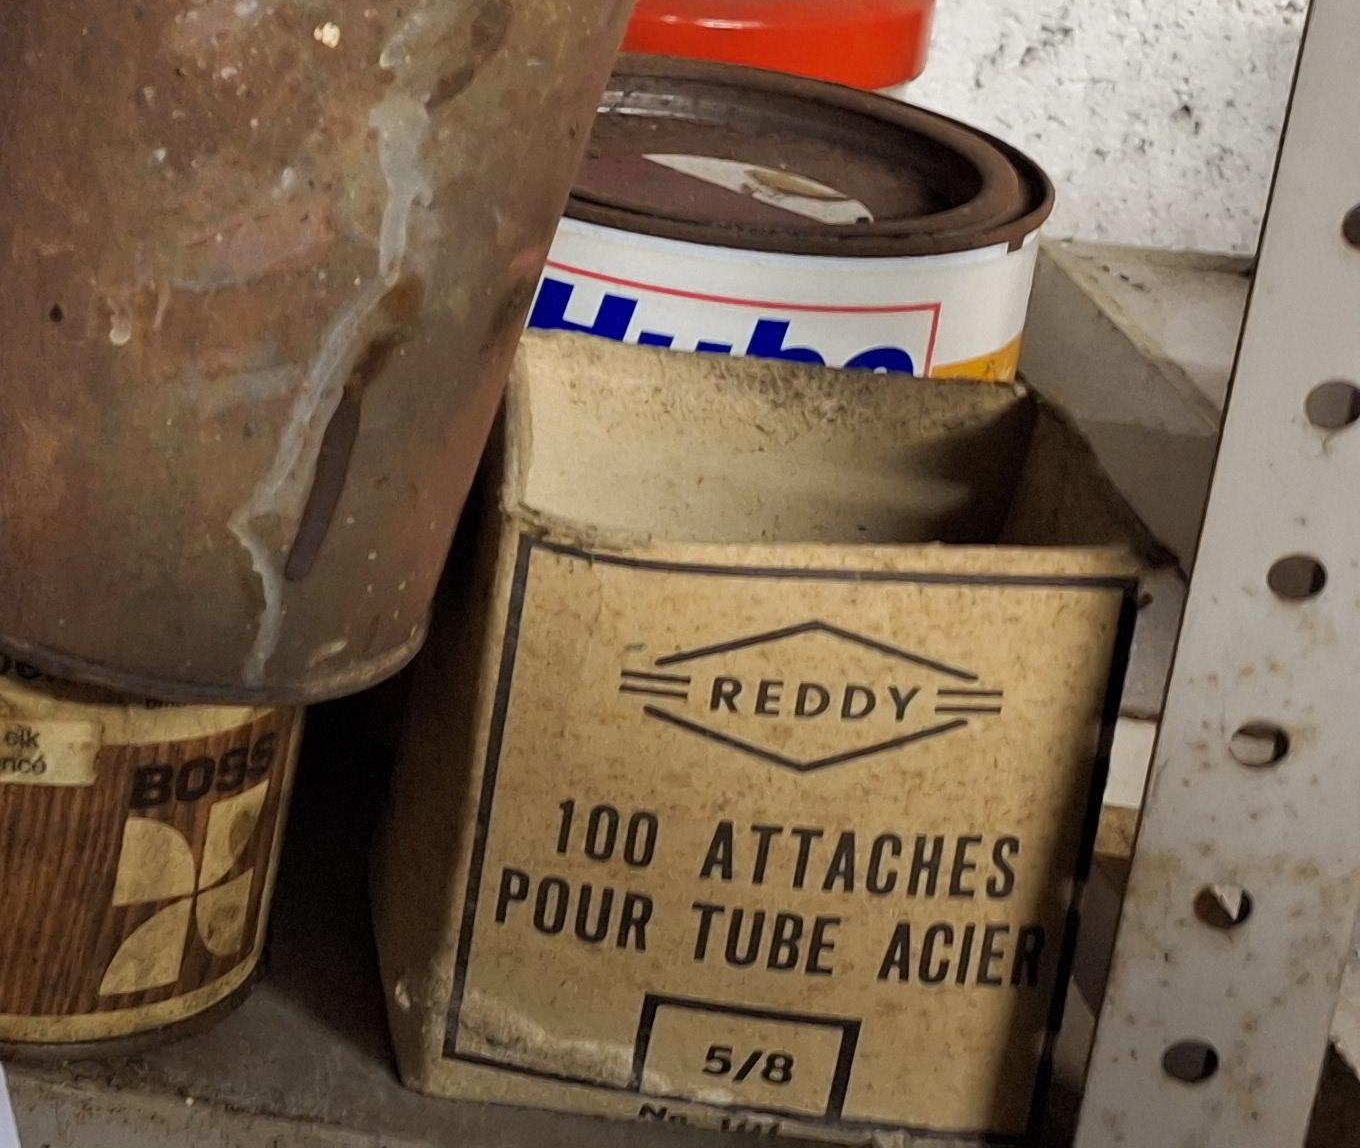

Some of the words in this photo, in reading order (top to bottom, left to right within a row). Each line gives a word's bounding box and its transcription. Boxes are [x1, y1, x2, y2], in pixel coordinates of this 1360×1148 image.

[708, 675, 922, 723] REDDY
[129, 731, 281, 810] BOSS
[555, 798, 660, 869] 100
[698, 819, 1021, 900] ATTACHES
[494, 867, 656, 952] POUR
[690, 901, 842, 976] TUBE
[877, 921, 1047, 989] ACIER
[701, 1044, 796, 1086] 5/8
